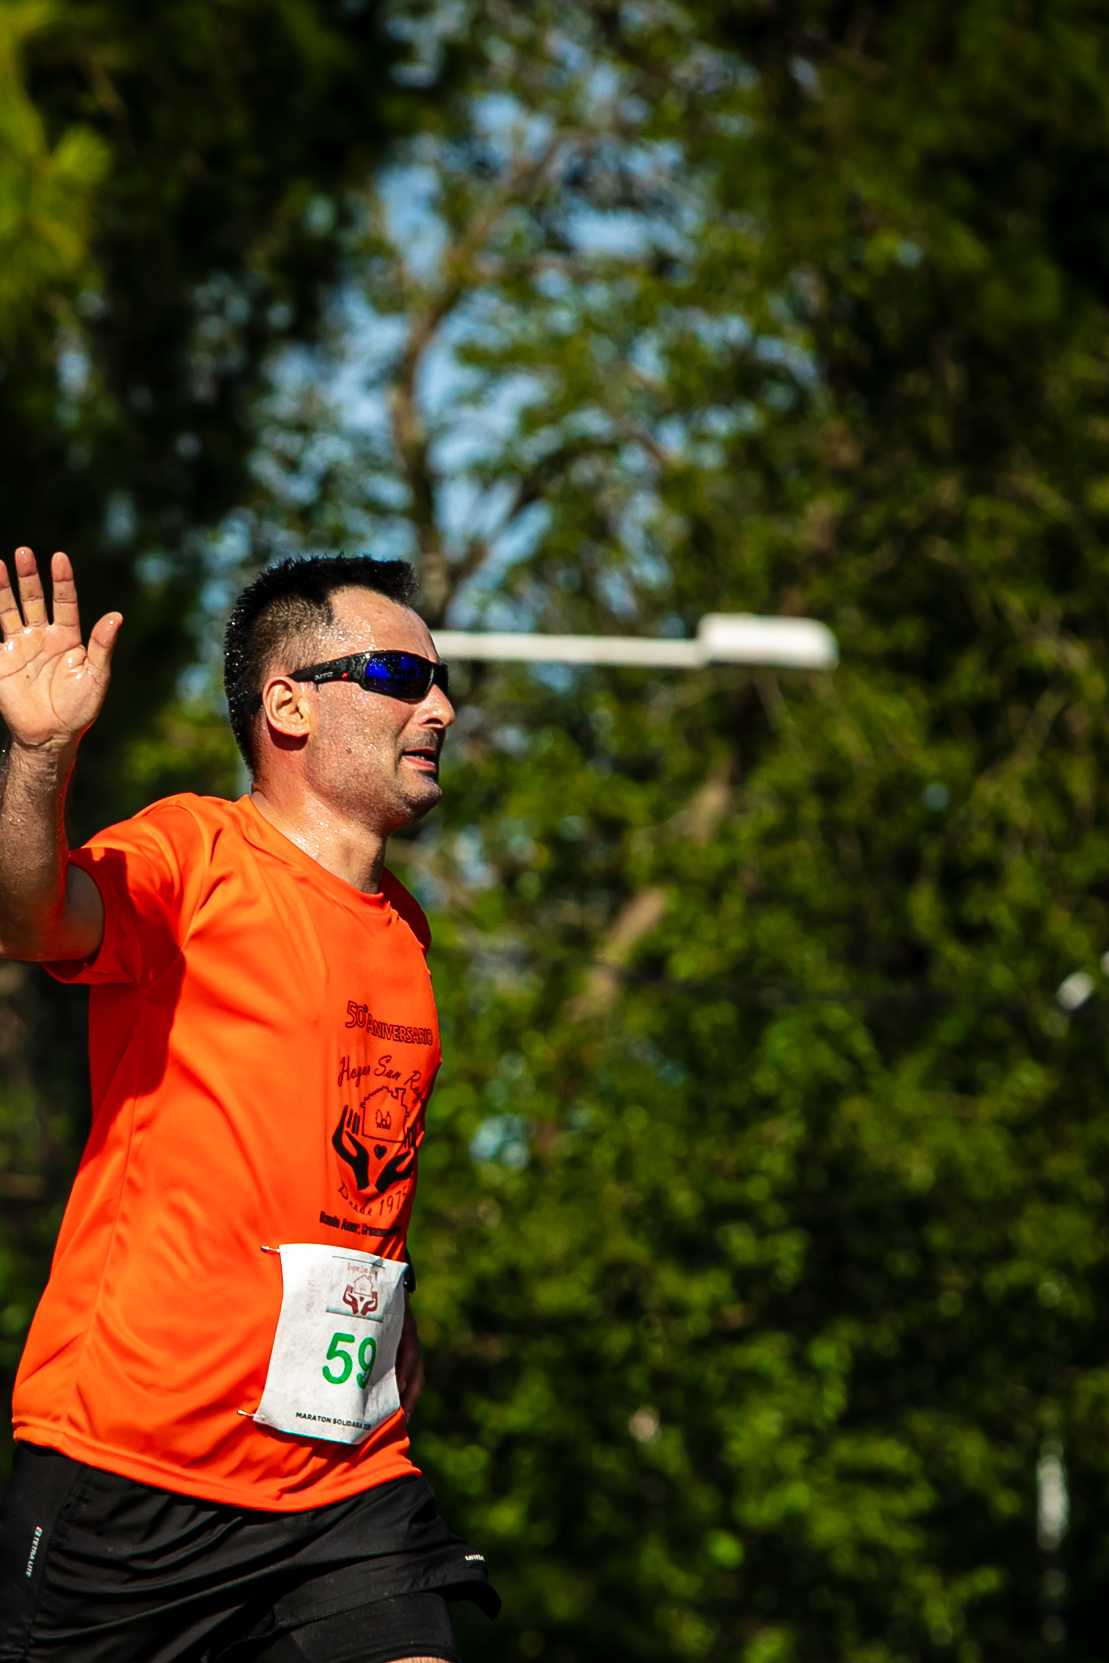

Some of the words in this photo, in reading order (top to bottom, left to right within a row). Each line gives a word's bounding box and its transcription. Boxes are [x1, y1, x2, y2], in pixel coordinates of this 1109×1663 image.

[366, 1013, 433, 1046] ANIVERSARIO
[338, 1055, 370, 1087] Hogar
[374, 1055, 401, 1080] San
[338, 1182, 372, 1216] Desde
[322, 1332, 377, 1389] 59
[295, 1412, 332, 1424] MARATON
